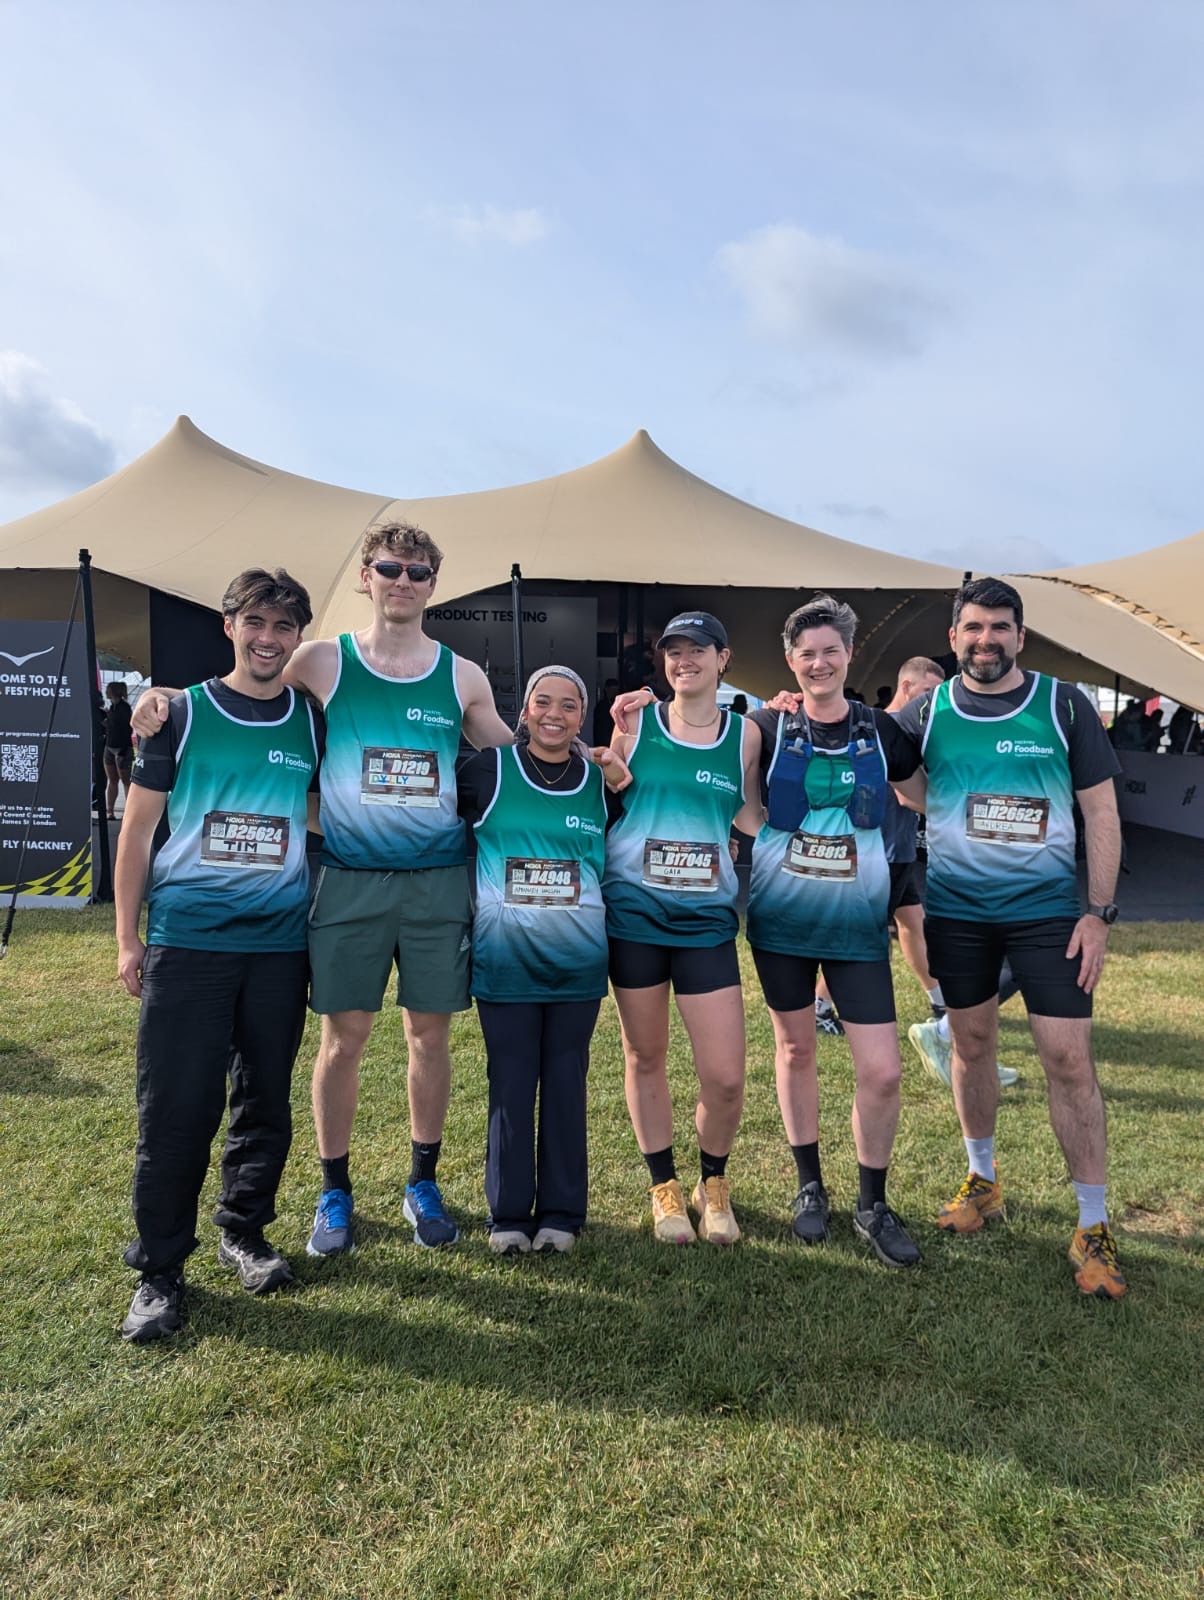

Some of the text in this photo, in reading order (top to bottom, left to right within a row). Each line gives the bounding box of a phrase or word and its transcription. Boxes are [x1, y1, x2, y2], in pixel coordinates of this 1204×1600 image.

[426, 609, 548, 623] PRODUCT TESTING
[28, 674, 45, 684] TO
[1014, 744, 1055, 755] Foodbank
[391, 759, 431, 776] D1219
[225, 816, 245, 824] HOKA
[987, 804, 1044, 823] H26523
[226, 823, 283, 843] B25624
[2, 839, 73, 851] FLY HACKNEY
[223, 840, 258, 853] TIM
[664, 851, 713, 868] B17045
[663, 867, 681, 875] GAIA
